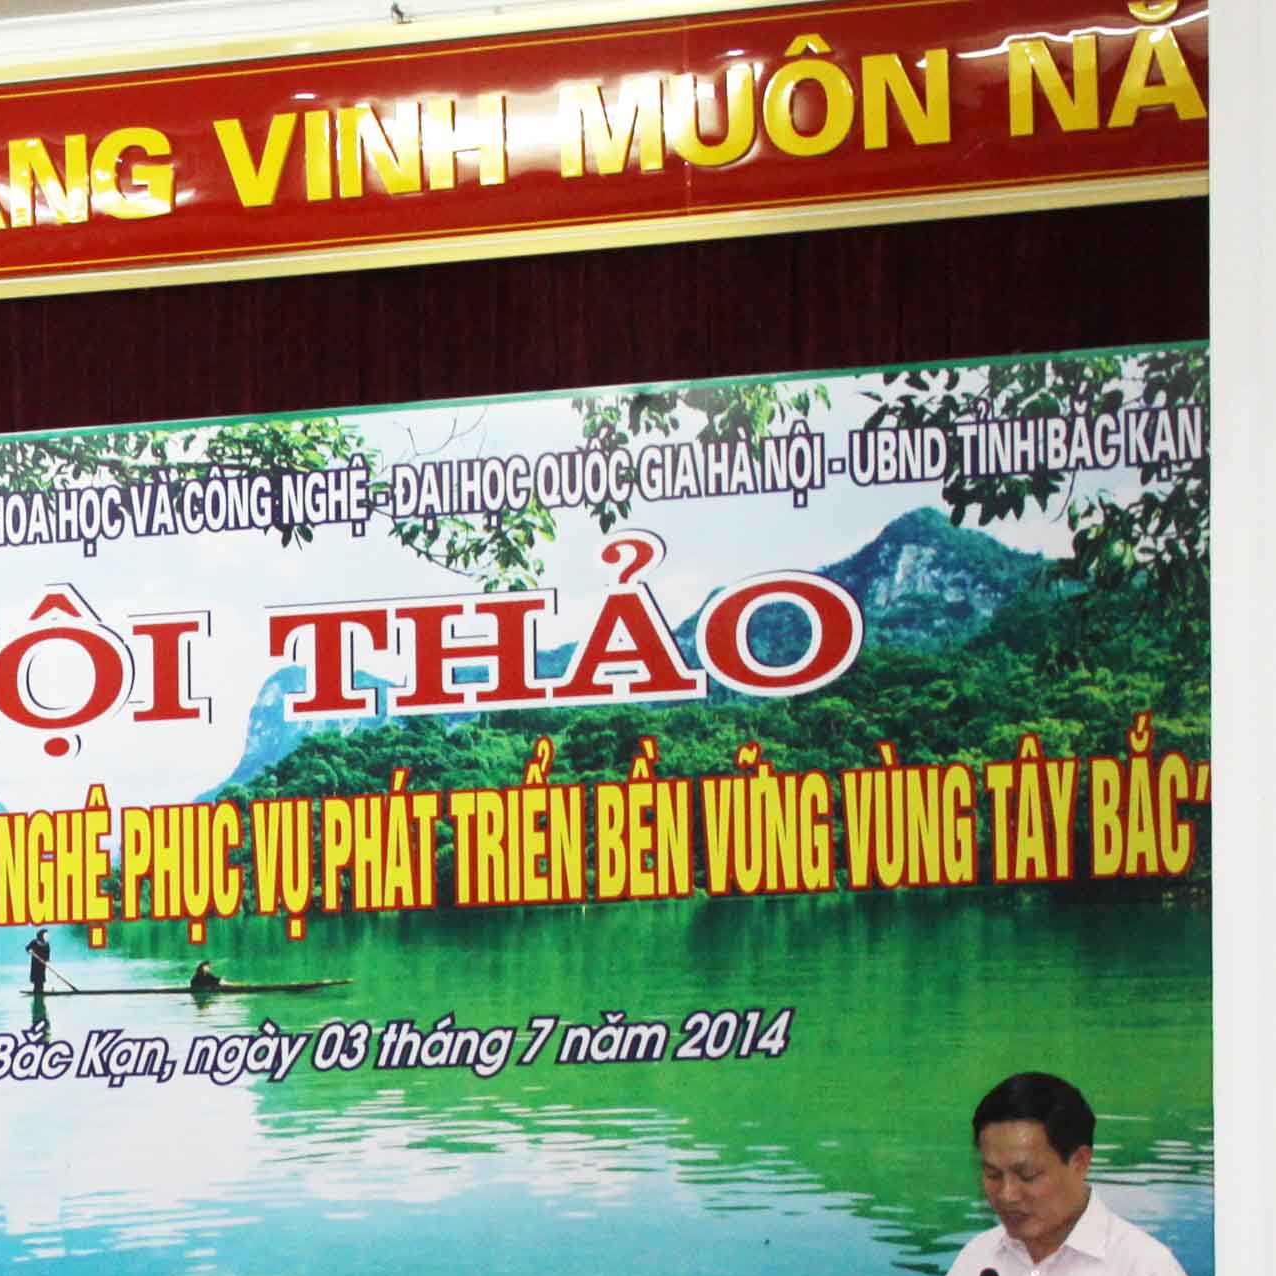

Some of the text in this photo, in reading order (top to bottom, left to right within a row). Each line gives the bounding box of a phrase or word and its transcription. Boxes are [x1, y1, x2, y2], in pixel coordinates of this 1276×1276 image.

[213, 91, 511, 209] VINH
[559, 36, 952, 180] MUÔN
[56, 486, 125, 558] HỌC
[130, 469, 178, 538] VÀ
[181, 463, 273, 533] CÔNG
[280, 453, 371, 538] NGHỆ
[392, 463, 450, 533] ĐẠI
[458, 455, 530, 530] HỌC
[535, 426, 633, 508] QUỐC
[636, 438, 702, 500] GIA
[706, 426, 758, 497] HÀ
[762, 418, 826, 508] NỘI
[850, 423, 948, 487] UBND
[954, 400, 1037, 477] TỈNH
[1046, 380, 1121, 471] BẮC
[1124, 405, 1203, 482] KẠN
[268, 536, 857, 712] THẢO
[121, 802, 244, 944] PHỤC
[250, 797, 316, 940] VỤ
[321, 766, 443, 914] PHÁT
[449, 736, 586, 910] TRIỂN
[595, 736, 694, 902] BỀN
[701, 745, 835, 896] VỮNG
[842, 740, 976, 888] VÙNG
[983, 732, 1079, 885] TÂY
[75, 1028, 177, 1088] Kạn,
[184, 1017, 310, 1085] ngày
[312, 1020, 373, 1073] 03
[374, 1011, 516, 1079] tháng
[517, 1014, 558, 1066] 7
[555, 1010, 669, 1065] năm
[671, 1006, 797, 1062] 2014
